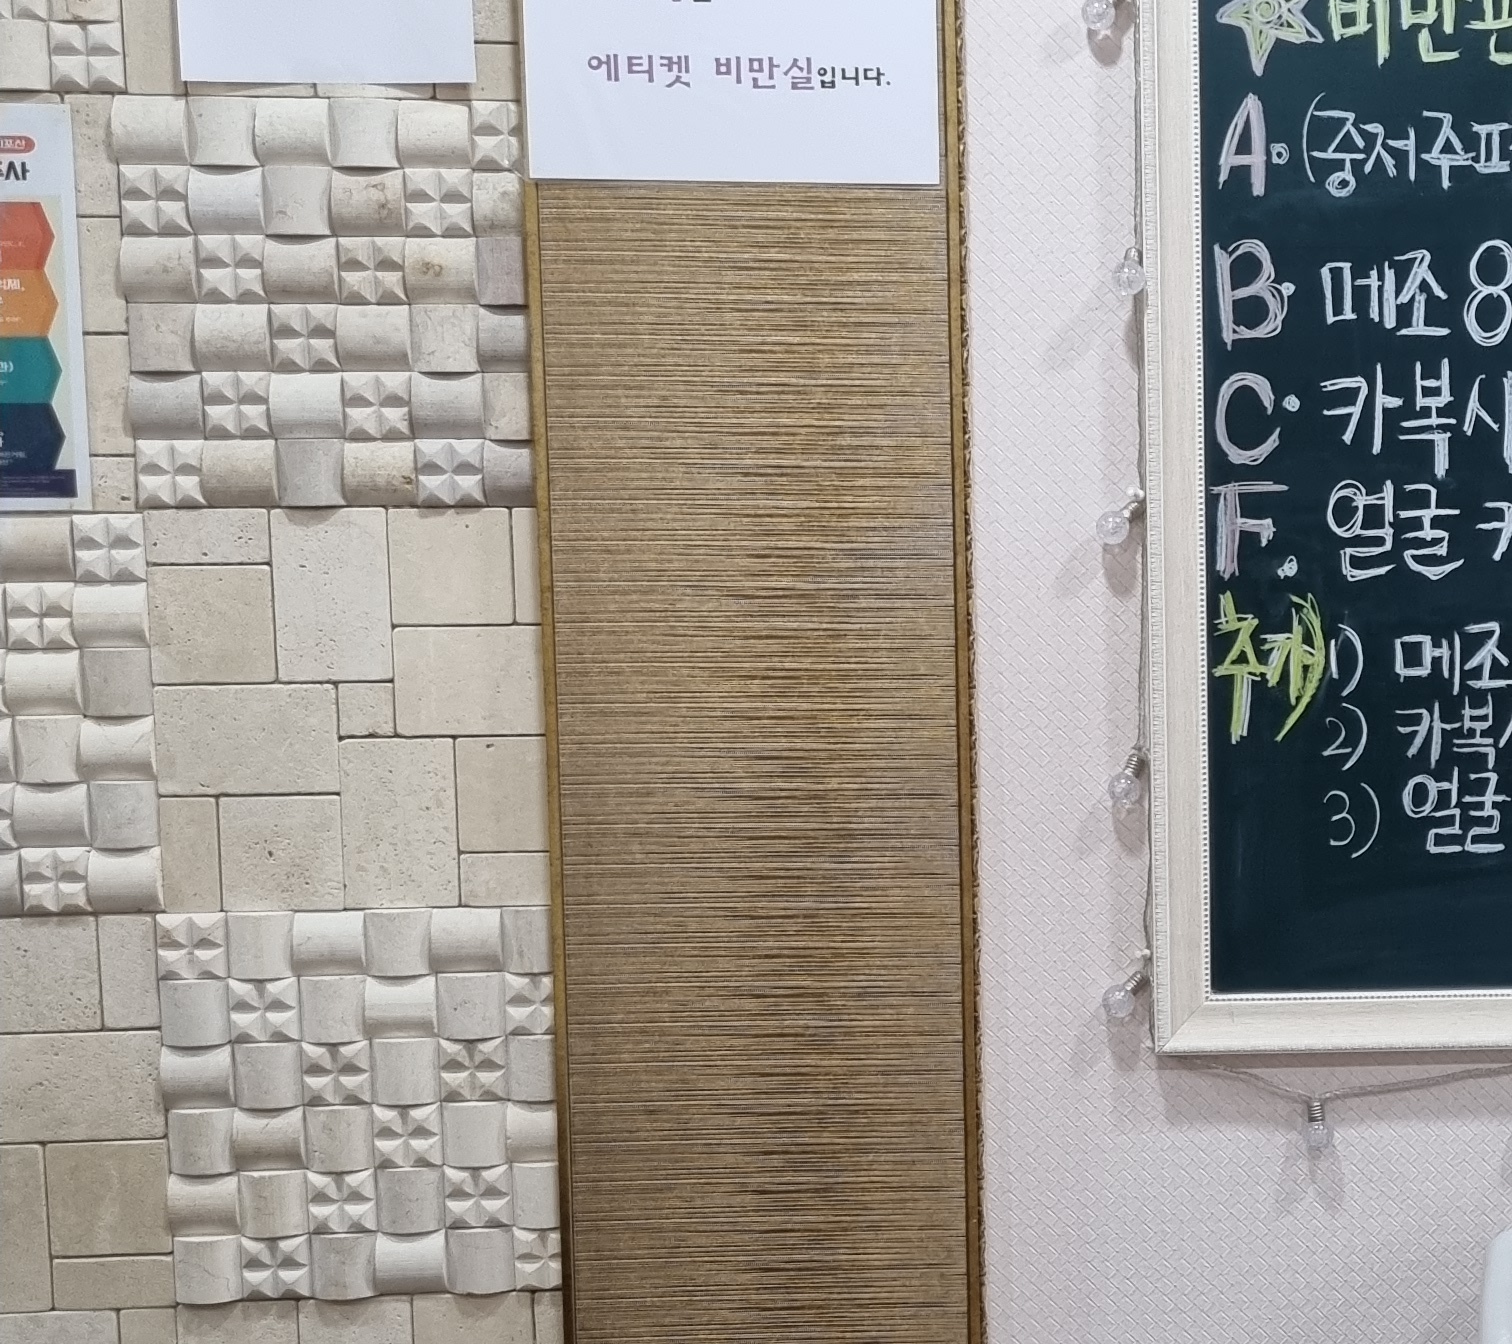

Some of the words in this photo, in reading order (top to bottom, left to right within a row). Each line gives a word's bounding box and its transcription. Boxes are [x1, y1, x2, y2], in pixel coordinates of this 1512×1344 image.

[587, 53, 691, 89] 에티켓
[714, 55, 892, 91] 비만실입니다.
[1326, 478, 1465, 582] 얼굴
[1321, 702, 1368, 771] 2)
[1322, 782, 1381, 859] 3)
[1402, 766, 1512, 854] 얼굴
